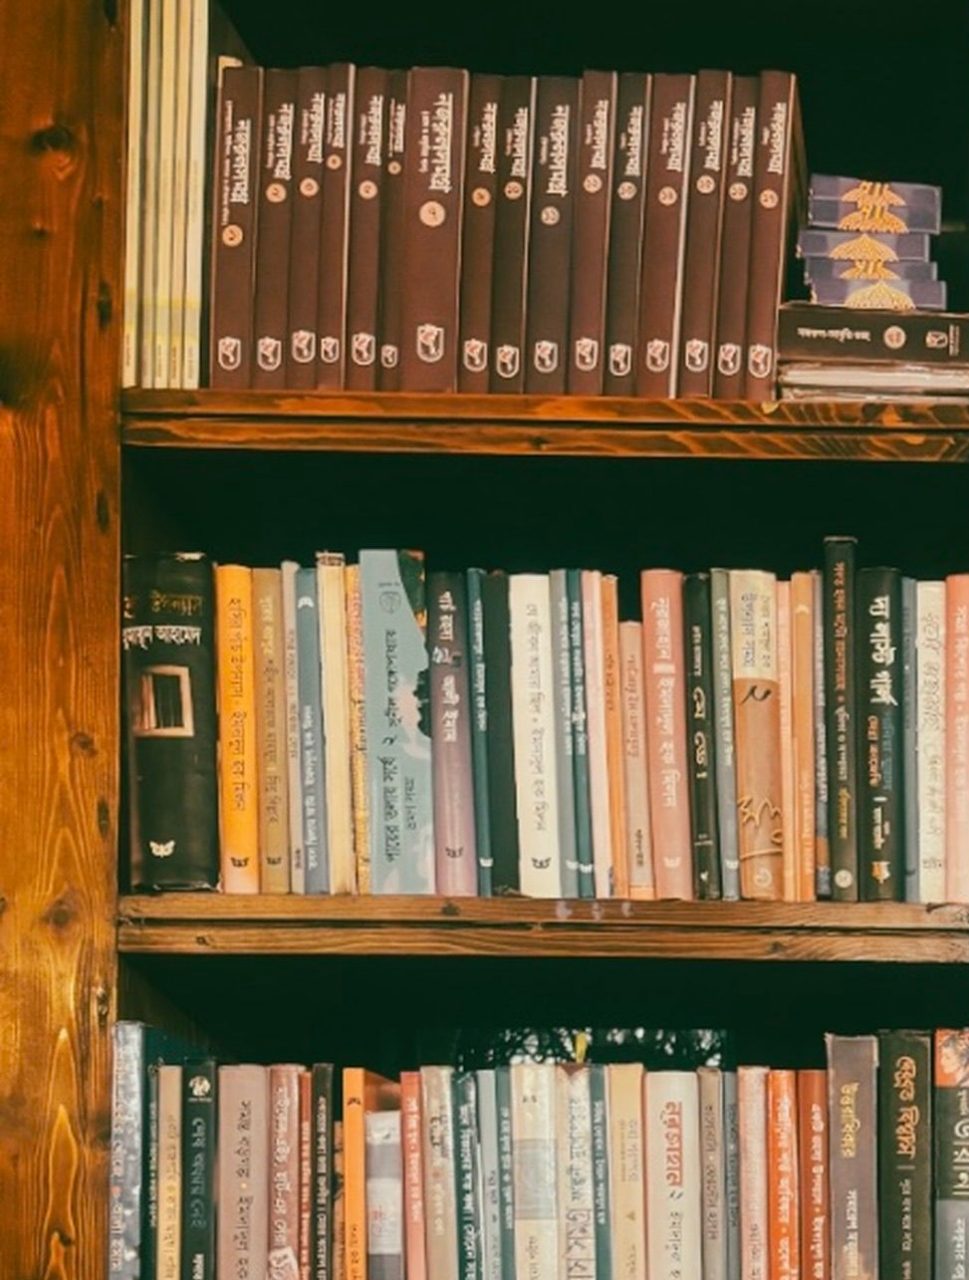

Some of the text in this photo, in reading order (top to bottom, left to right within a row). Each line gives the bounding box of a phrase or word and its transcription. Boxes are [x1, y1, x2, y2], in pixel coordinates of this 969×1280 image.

[654, 677, 675, 734] ইমদাদুল
[661, 742, 674, 763] হক
[661, 769, 680, 807] মিলন
[659, 1101, 683, 1187] নূরজাহান
[238, 1258, 249, 1279] হক
